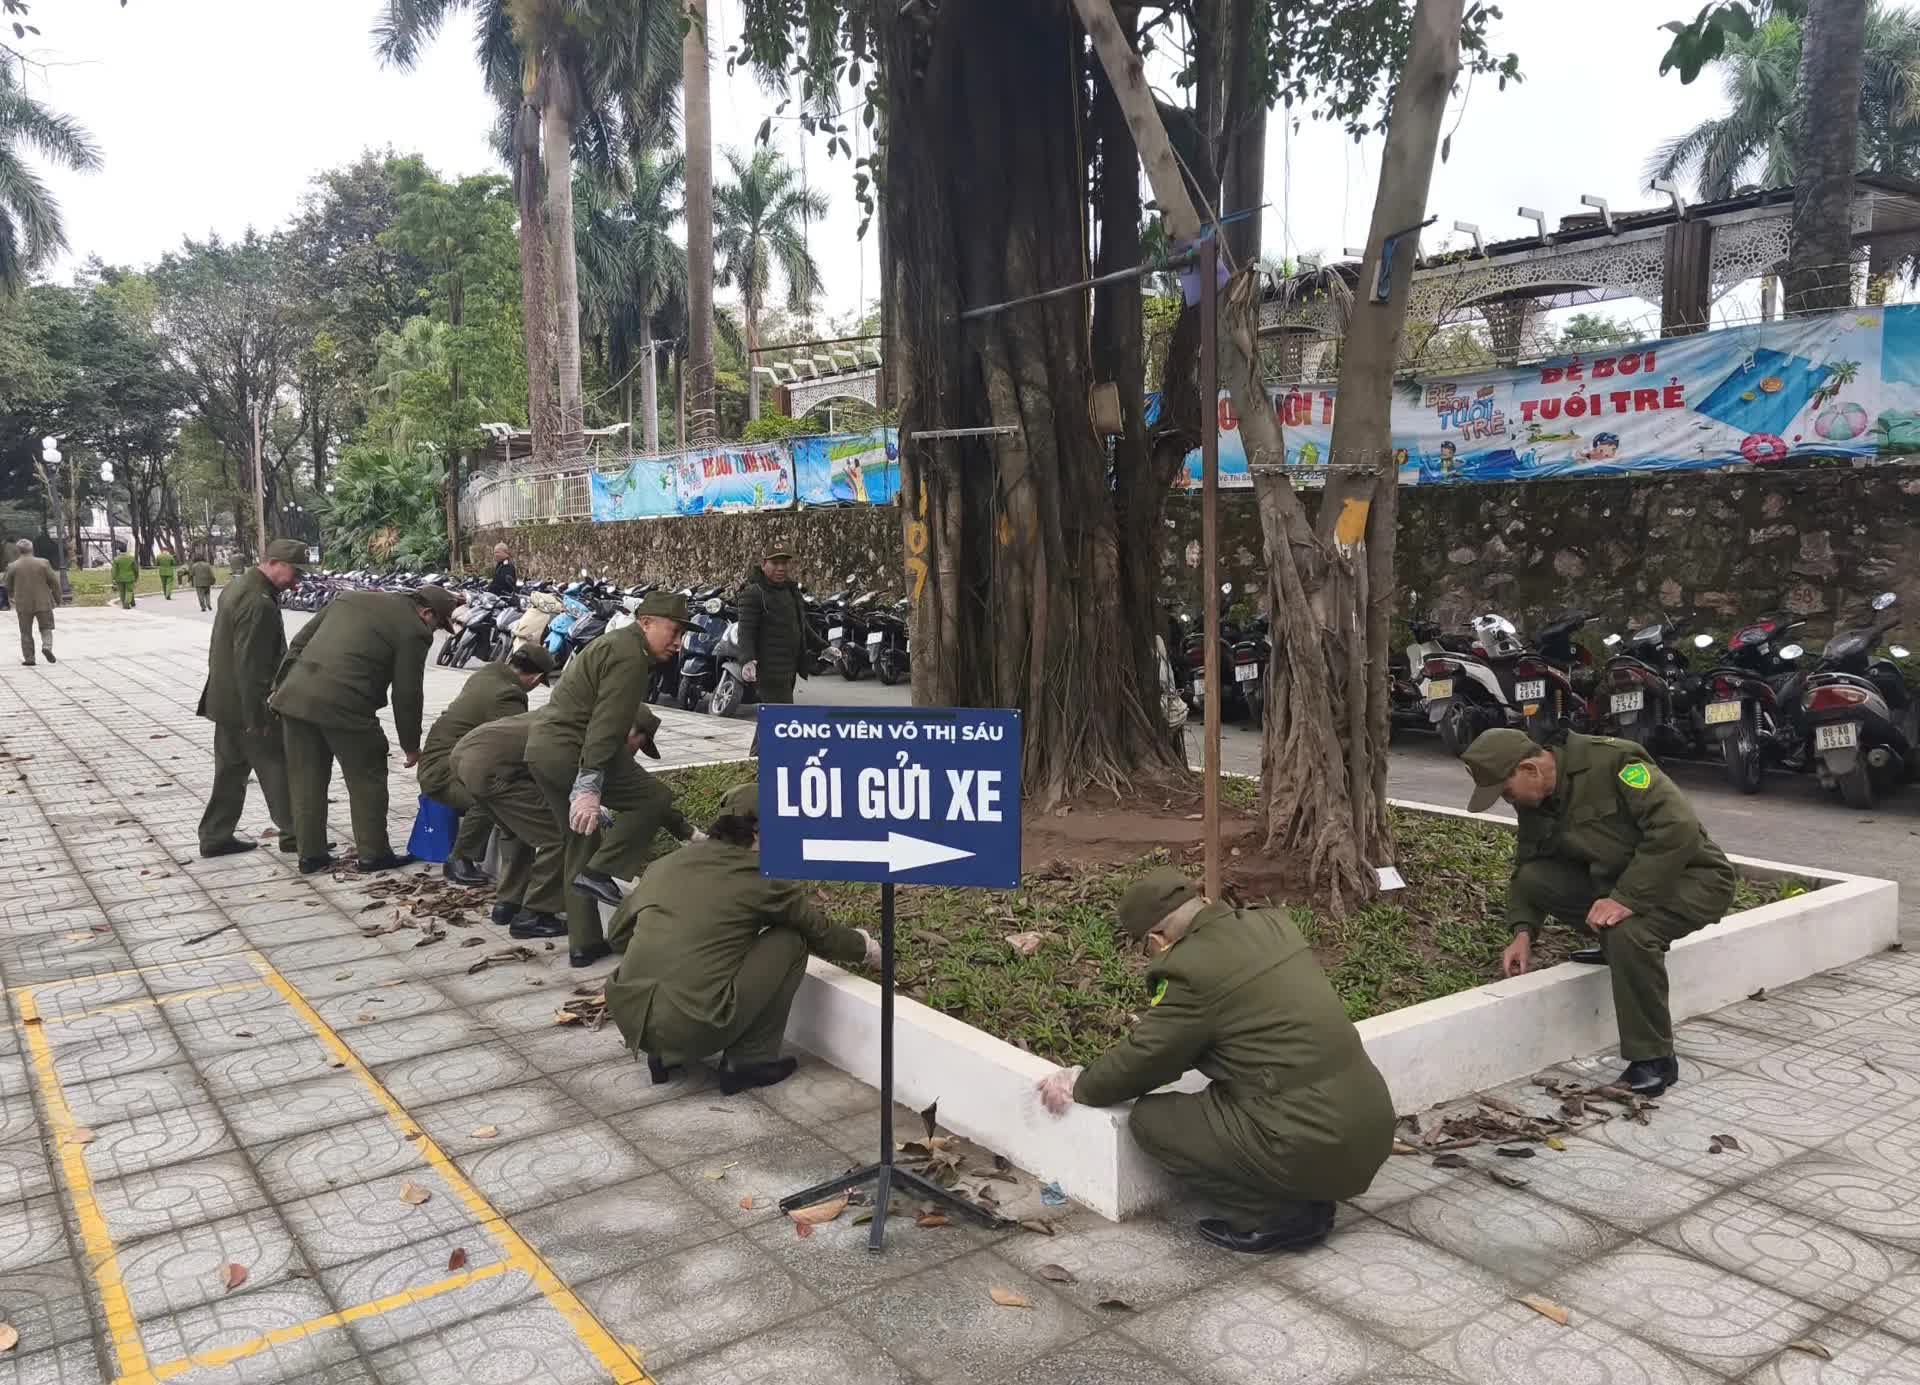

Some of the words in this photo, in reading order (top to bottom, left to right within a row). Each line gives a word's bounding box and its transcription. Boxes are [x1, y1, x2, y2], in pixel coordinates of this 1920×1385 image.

[1520, 384, 1601, 422] TUỔI
[1610, 377, 1685, 414] TRẺ
[774, 720, 831, 739] CÔNG
[836, 720, 883, 740] VIÊN
[888, 721, 918, 741] VÕ
[923, 725, 956, 744] THỊ
[962, 721, 1003, 741] SÁU
[776, 748, 843, 818] LỐI
[858, 751, 930, 820] GỬI
[946, 769, 1003, 822] XE
